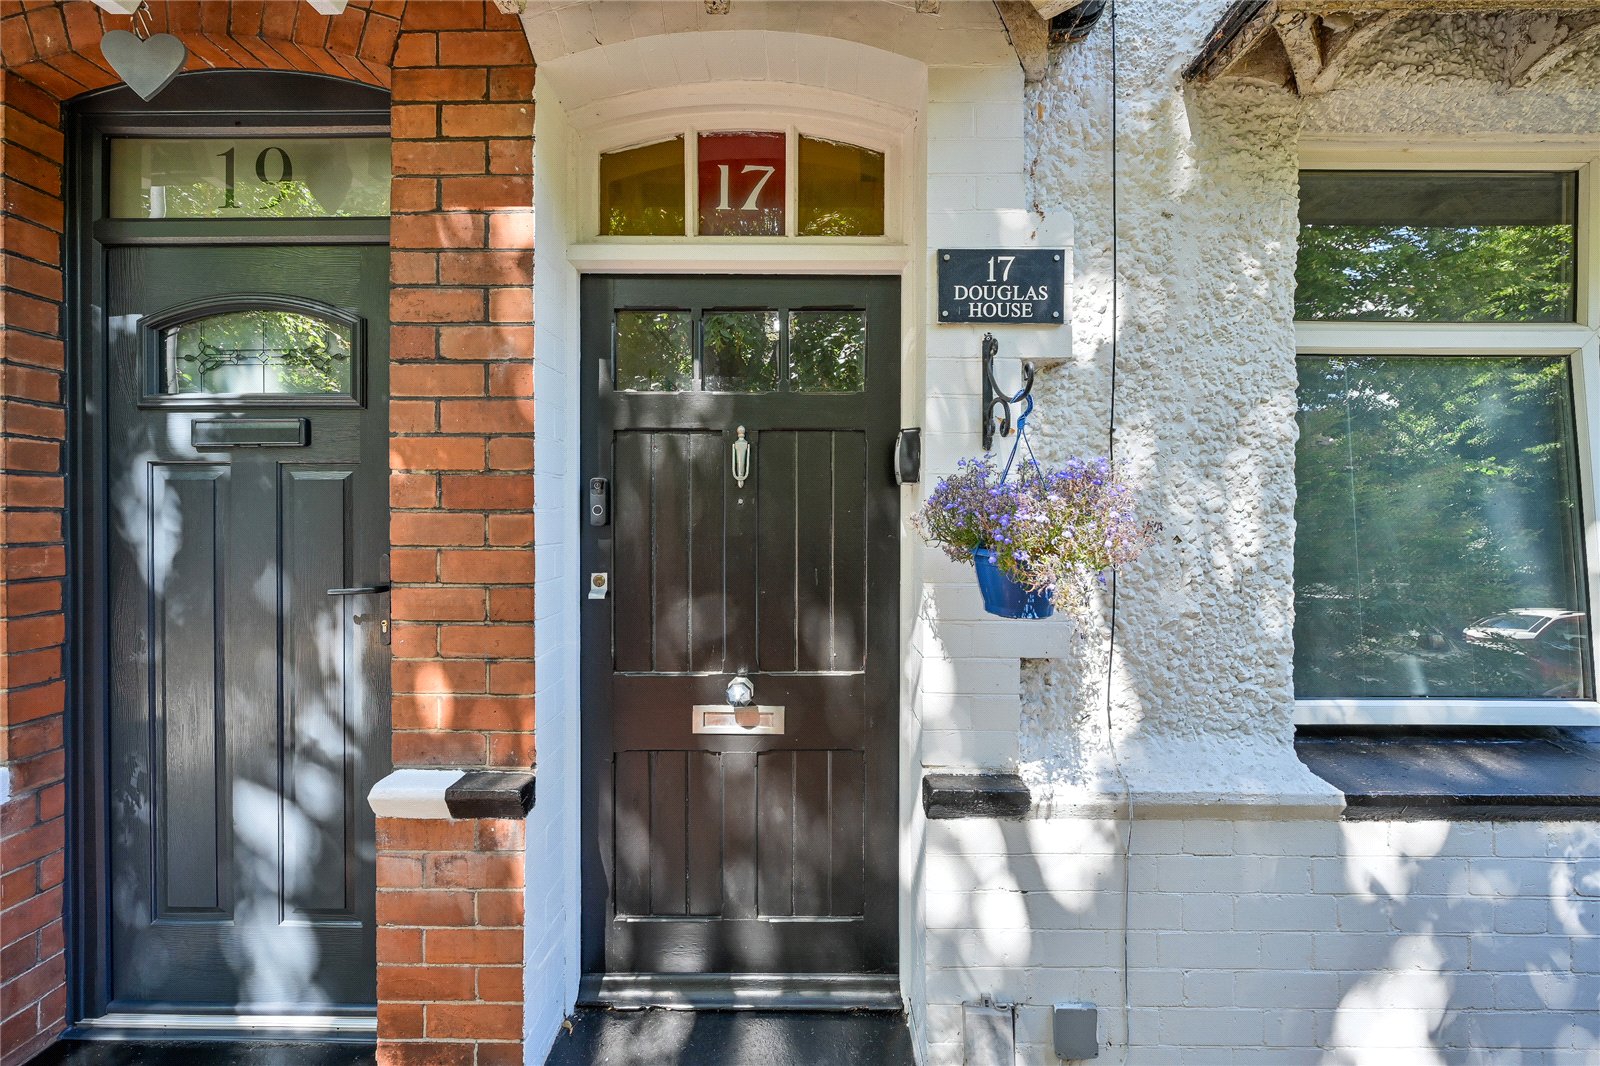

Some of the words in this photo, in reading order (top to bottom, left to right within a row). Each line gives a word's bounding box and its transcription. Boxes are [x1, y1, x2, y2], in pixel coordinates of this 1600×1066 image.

[216, 147, 293, 210] 19
[715, 164, 776, 211] 17
[986, 256, 1016, 282] 17
[953, 285, 1049, 301] DOUGLAS
[968, 302, 1034, 318] HOUSE
